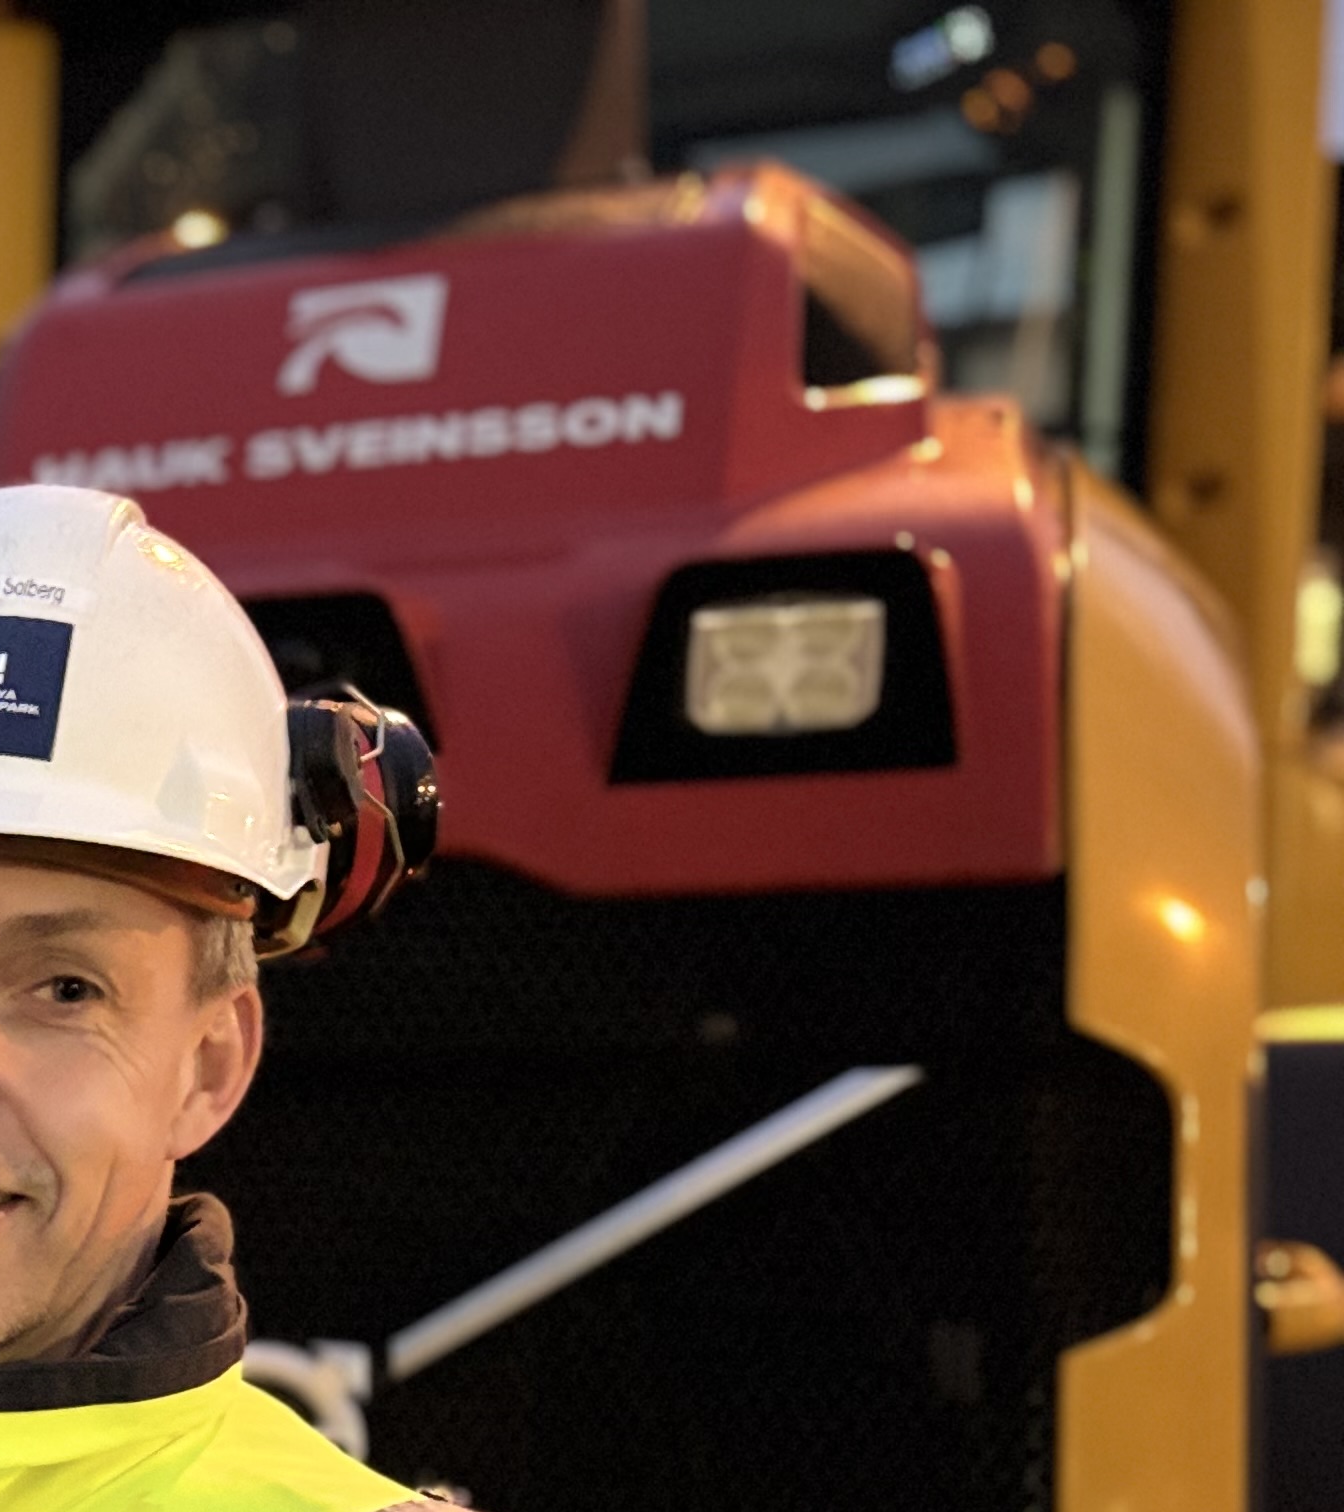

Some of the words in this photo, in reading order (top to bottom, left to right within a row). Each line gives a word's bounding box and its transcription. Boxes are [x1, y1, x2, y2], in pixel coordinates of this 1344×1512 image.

[34, 436, 231, 491] HAUK
[244, 392, 684, 480] SVEINSSON
[3, 577, 66, 605] Solberg
